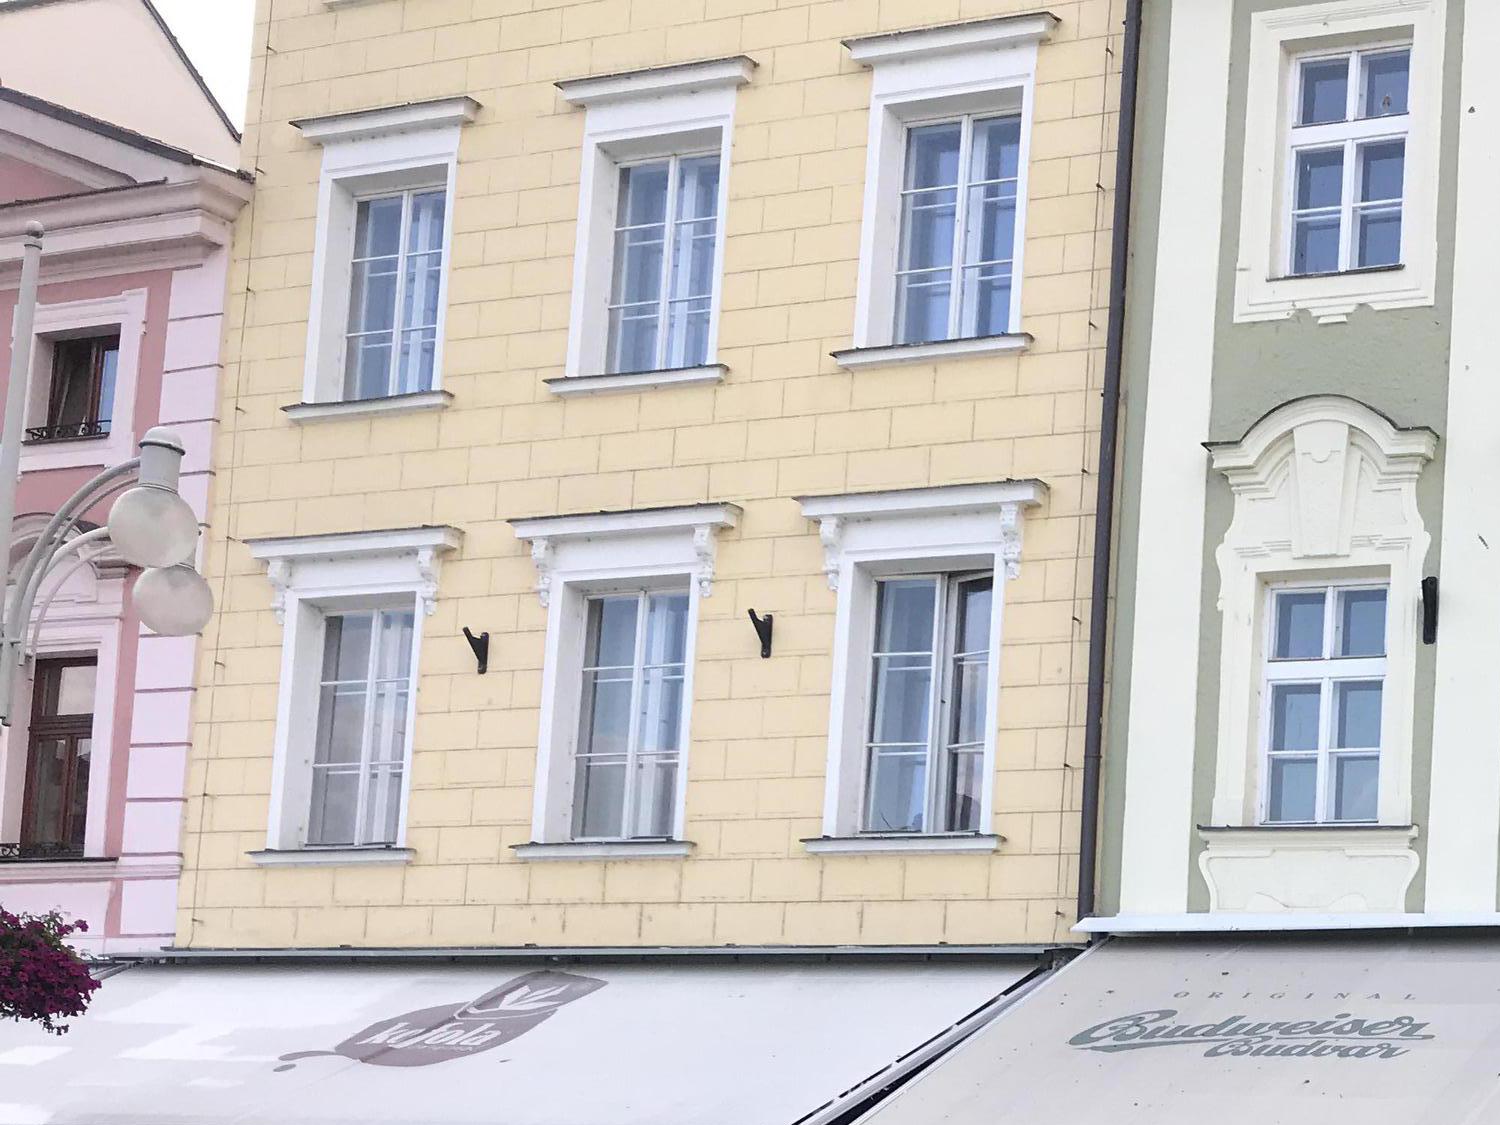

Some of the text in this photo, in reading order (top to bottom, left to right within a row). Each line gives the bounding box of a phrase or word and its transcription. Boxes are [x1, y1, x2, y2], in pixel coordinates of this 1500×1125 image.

[1173, 990, 1416, 1000] ORIGINAL
[1069, 1009, 1436, 1051] Budweiser
[1203, 1037, 1411, 1060] Budvar
